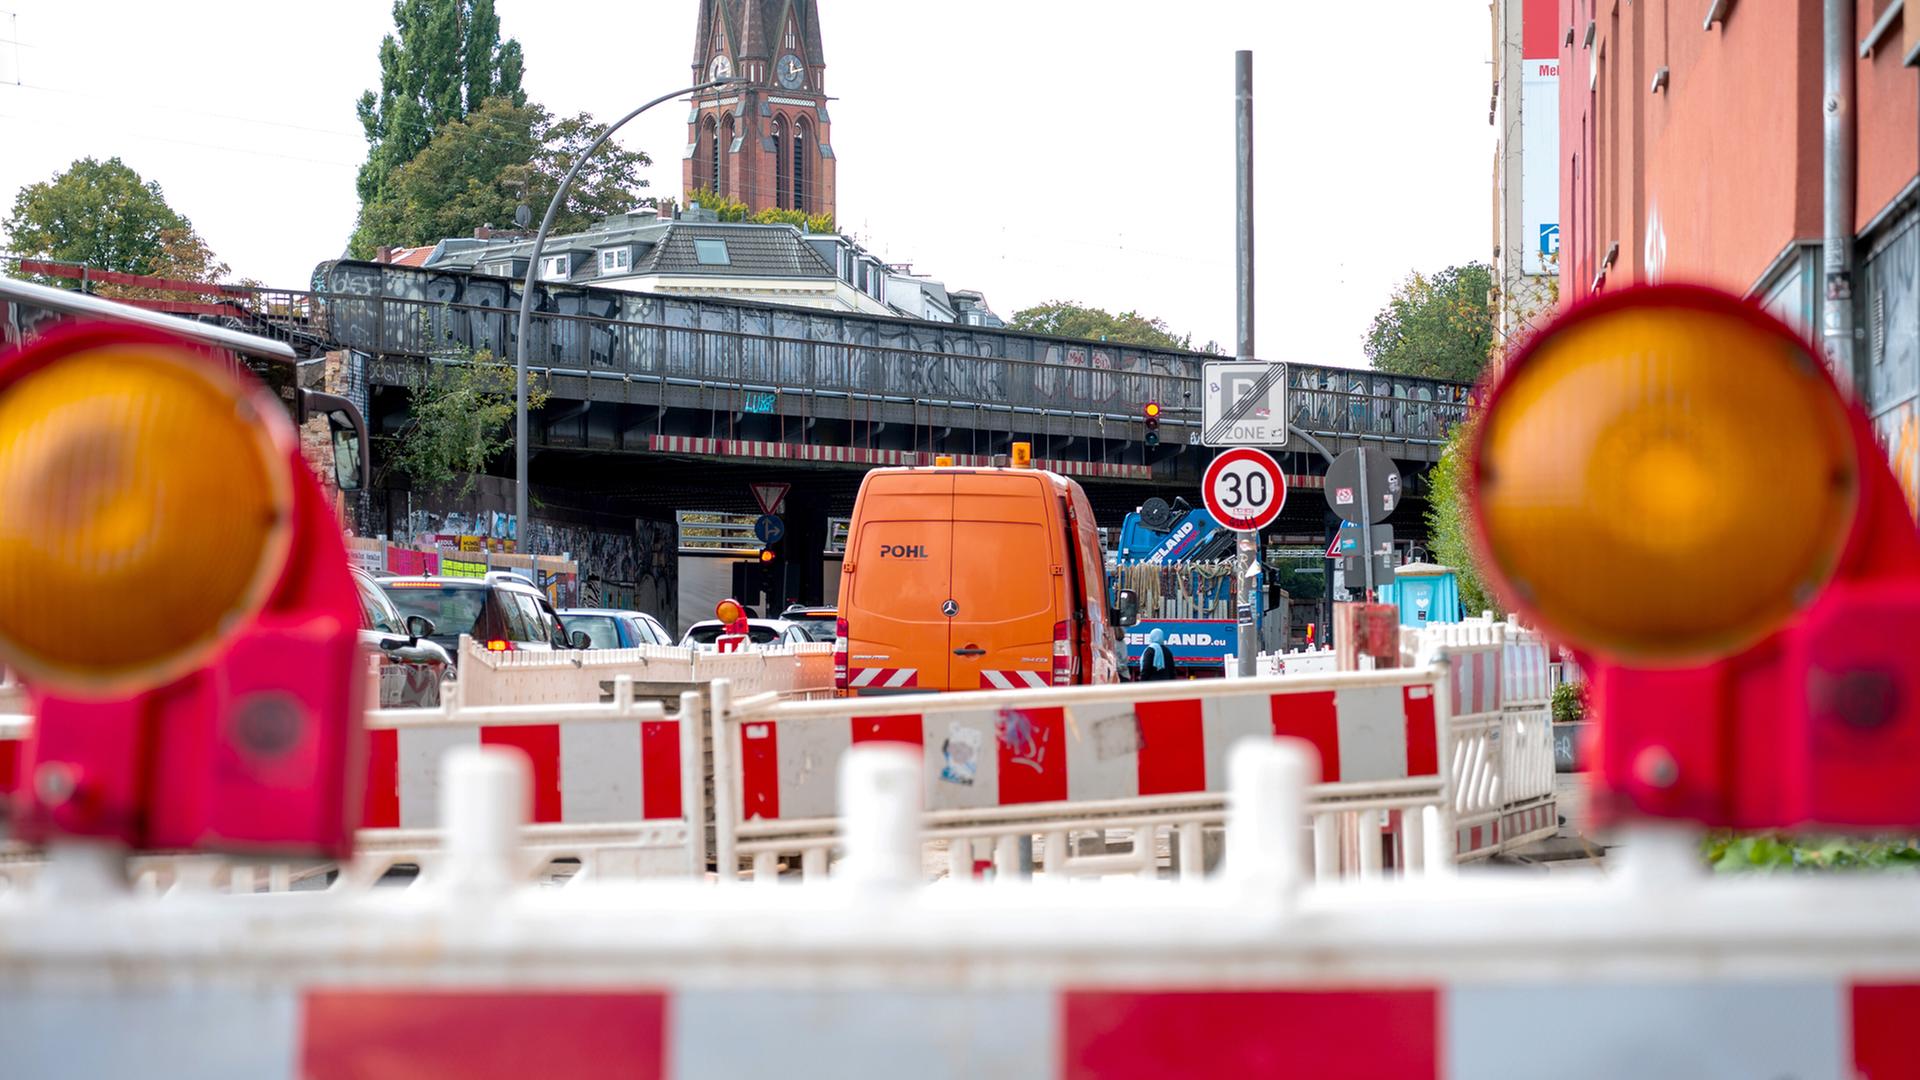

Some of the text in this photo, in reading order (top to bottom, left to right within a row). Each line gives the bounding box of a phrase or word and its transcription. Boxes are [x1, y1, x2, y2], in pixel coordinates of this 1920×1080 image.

[1225, 426, 1265, 440] ZONE
[1221, 471, 1267, 508] 30
[880, 545, 929, 558] POHL
